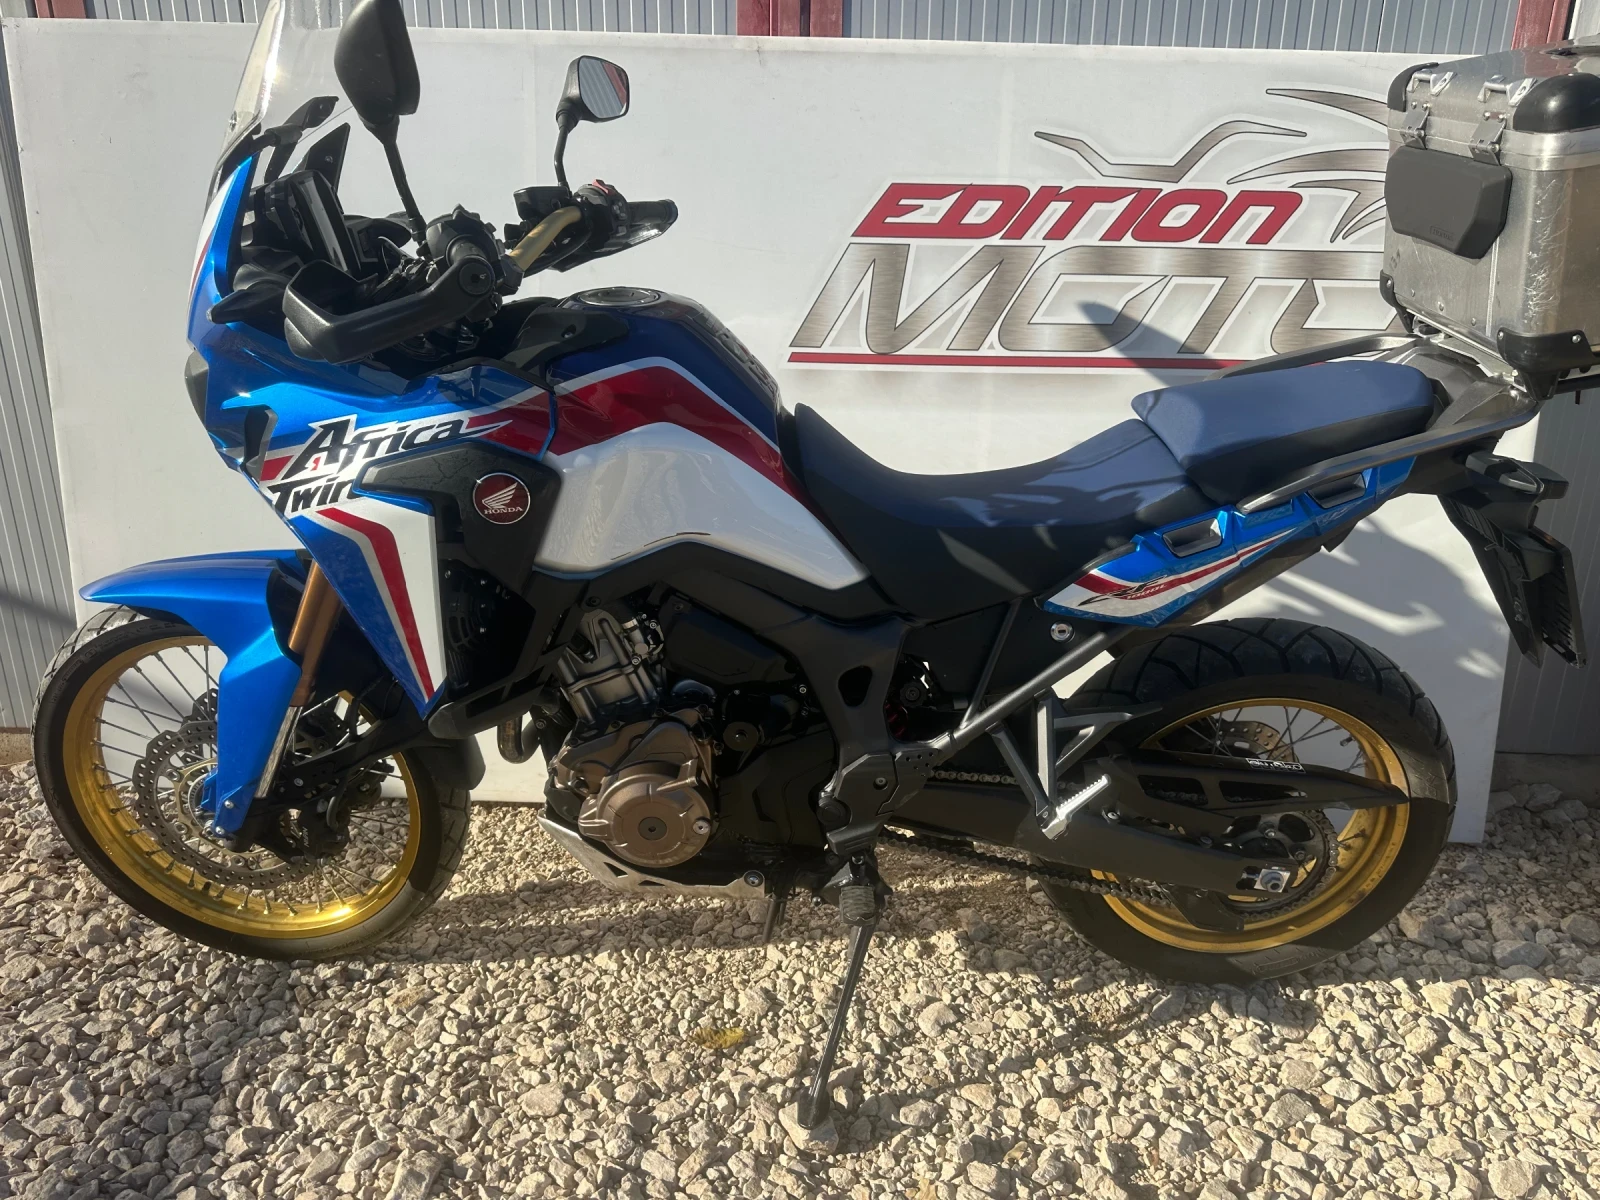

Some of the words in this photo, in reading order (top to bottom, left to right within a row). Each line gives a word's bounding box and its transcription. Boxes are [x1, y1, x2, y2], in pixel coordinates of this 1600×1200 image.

[851, 182, 1303, 244] EDITION
[281, 419, 501, 480] Africa
[267, 473, 363, 515] Twin
[484, 506, 523, 515] HONDA
